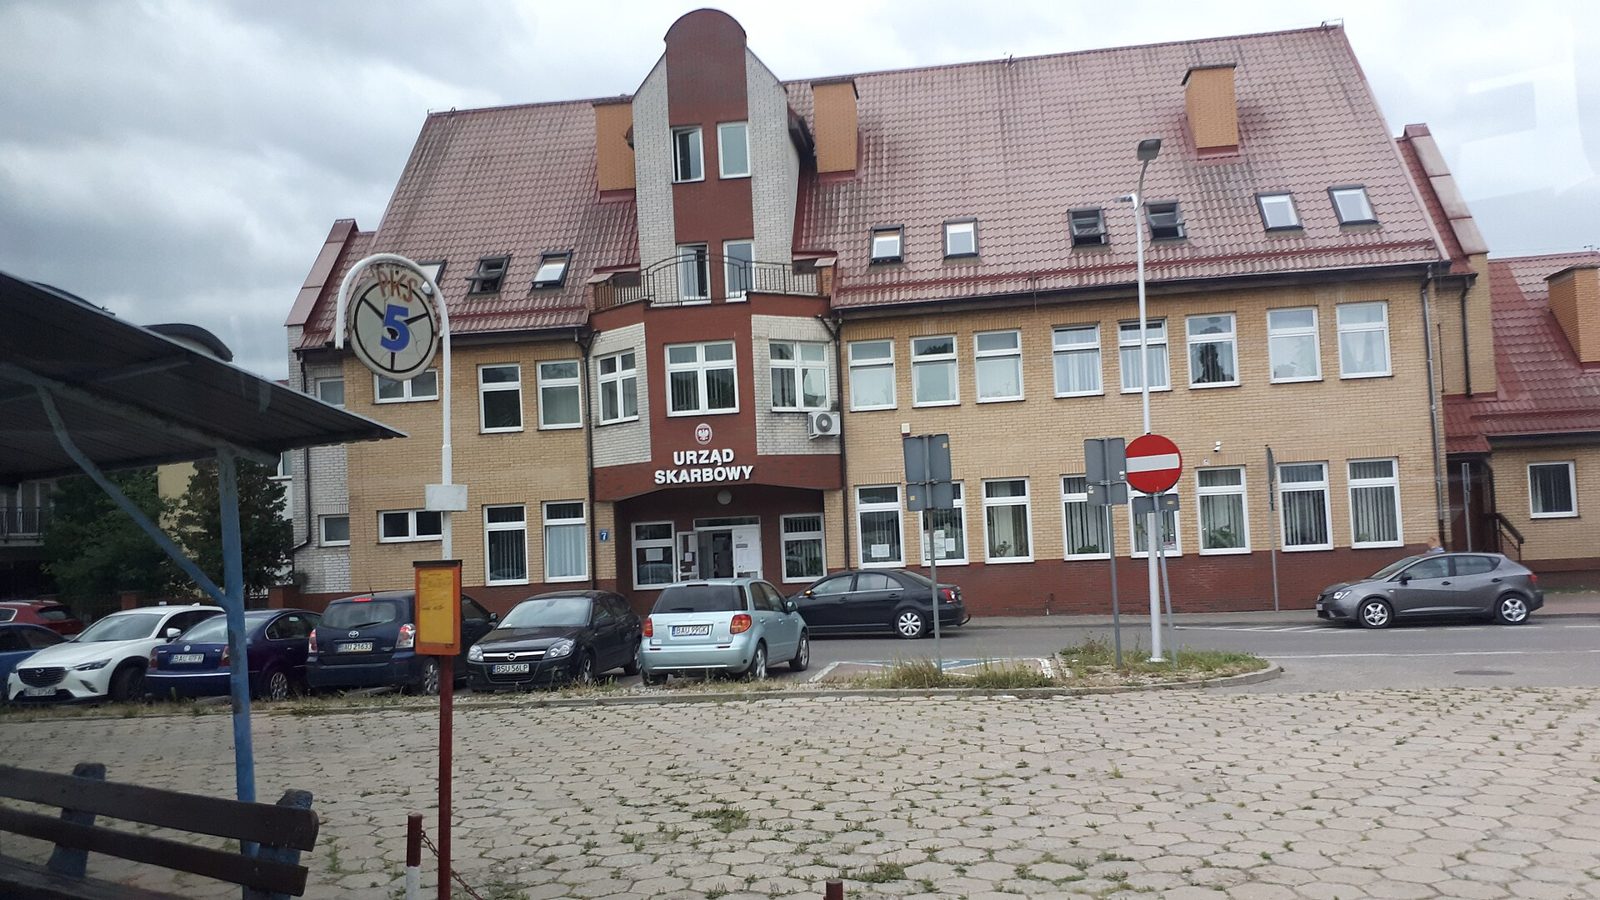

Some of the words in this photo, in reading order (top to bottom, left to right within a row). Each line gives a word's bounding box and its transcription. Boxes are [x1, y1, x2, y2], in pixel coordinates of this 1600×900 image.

[377, 270, 418, 302] PKS
[380, 304, 410, 352] 5
[673, 448, 735, 466] URZĄD
[654, 465, 754, 485] SKARBOWY
[601, 532, 607, 541] 7
[496, 665, 511, 673] BSU
[511, 664, 528, 672] 56LP
